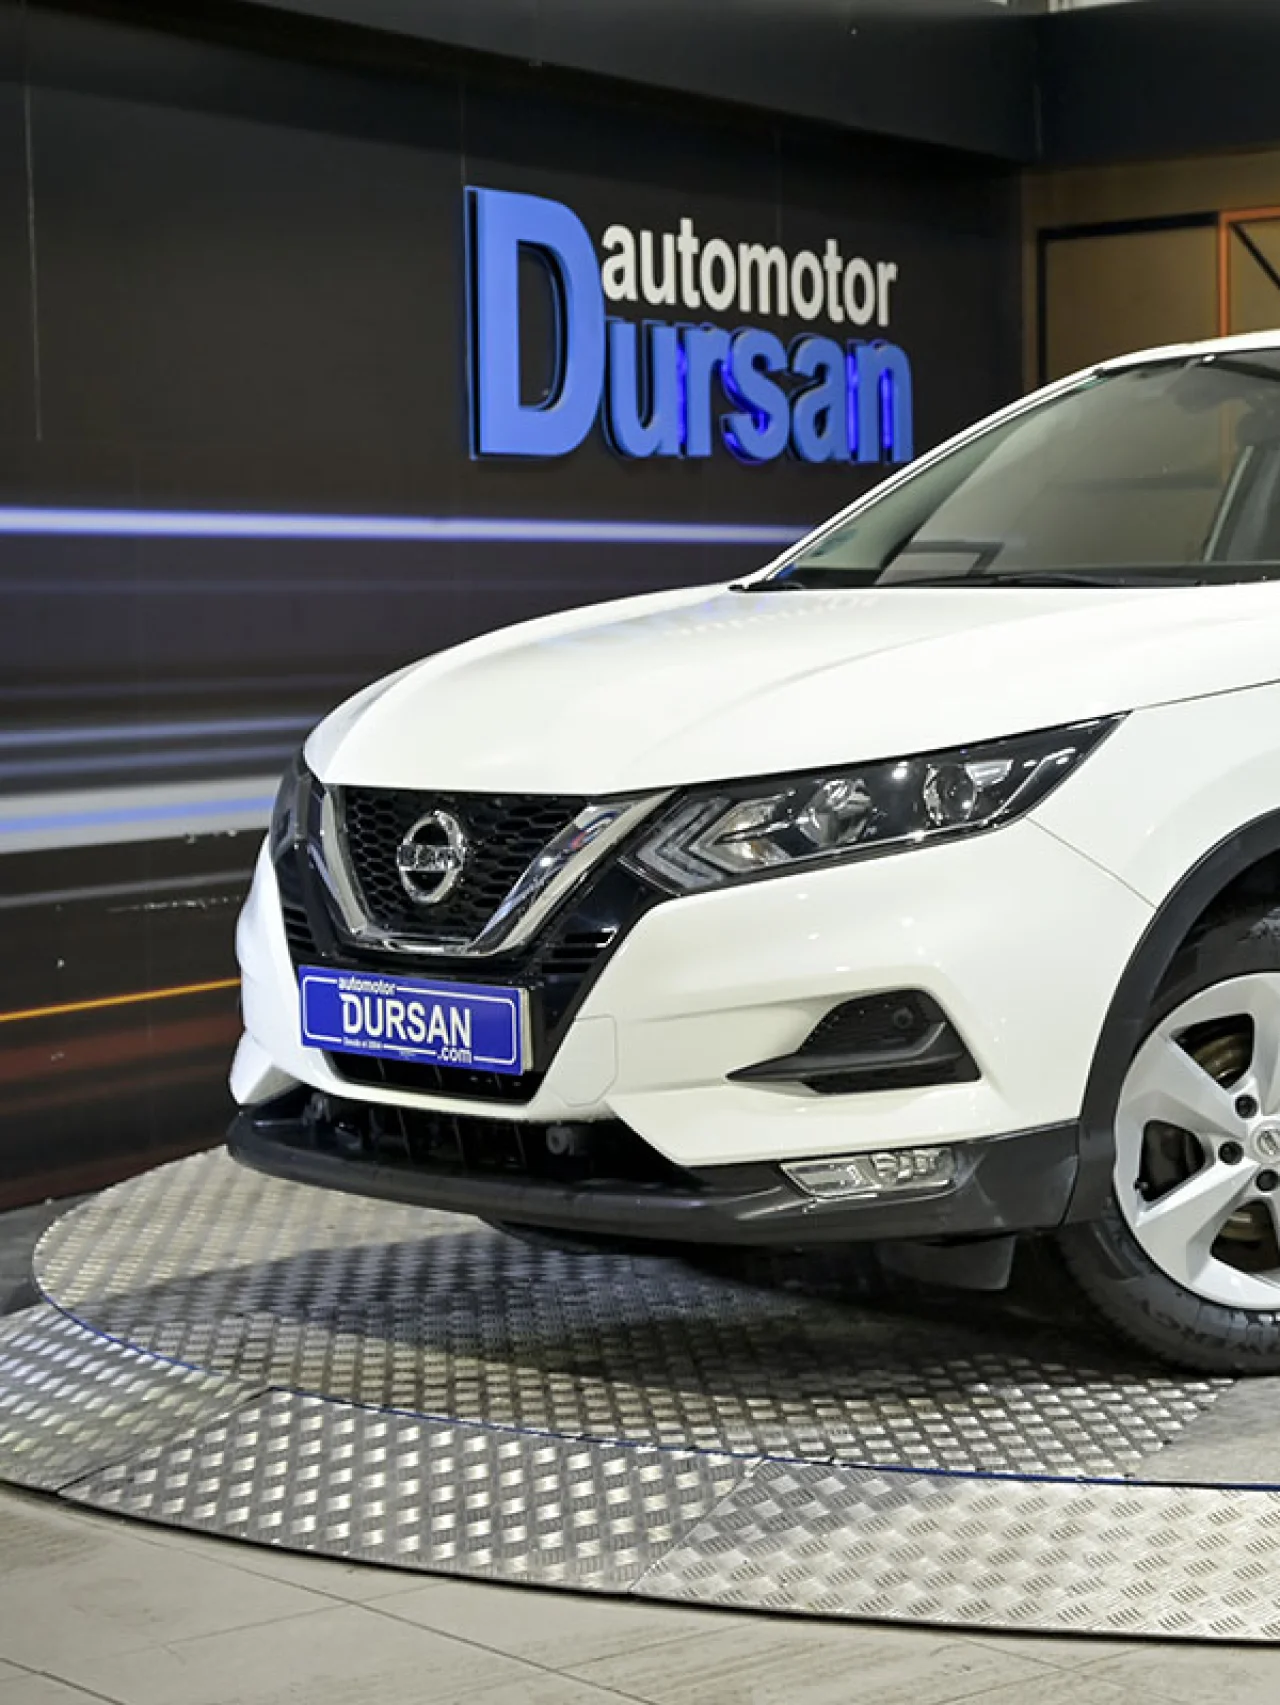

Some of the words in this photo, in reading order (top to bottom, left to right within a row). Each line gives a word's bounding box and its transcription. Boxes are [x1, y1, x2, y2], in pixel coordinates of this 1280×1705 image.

[601, 217, 898, 327] automotor
[464, 185, 914, 465] Dursan
[338, 975, 396, 995] automotor
[338, 992, 472, 1048] DURSAN
[437, 1045, 473, 1065] .com
